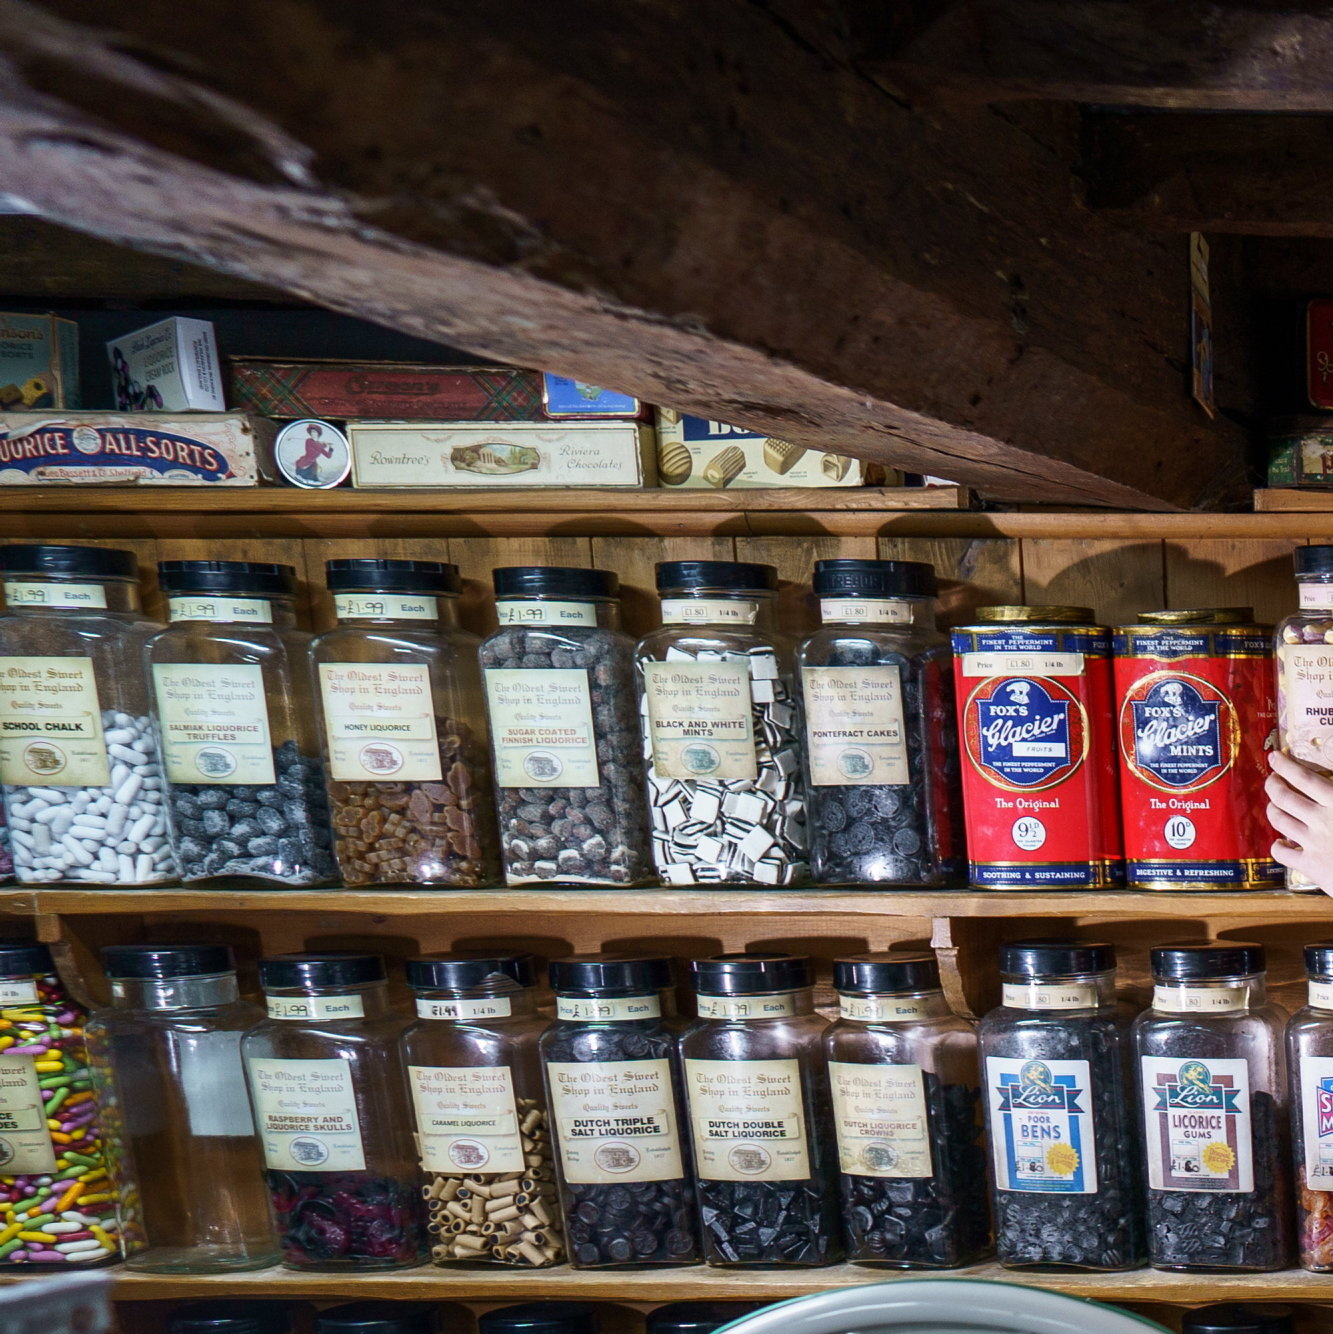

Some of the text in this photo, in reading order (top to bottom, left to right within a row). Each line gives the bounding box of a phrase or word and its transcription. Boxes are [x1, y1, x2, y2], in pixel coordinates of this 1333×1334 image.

[105, 432, 219, 471] ALL-SORTS
[559, 445, 600, 458] Riviera
[369, 452, 431, 468] Rowntree's
[565, 458, 623, 470] Chocolates
[989, 706, 1028, 716] FOX'S
[1145, 707, 1182, 717] FOX'S
[2, 721, 84, 731] SCHOOL CHALK
[655, 720, 745, 730] BLACK AND WHITE
[1137, 713, 1215, 747] Glacier
[683, 728, 714, 737] MINTS
[813, 730, 898, 738] PONTEFRACT CAKES
[983, 712, 1065, 751] Glacier
[1170, 746, 1213, 756] MINTS
[995, 798, 1059, 811] The Original
[1150, 799, 1210, 811] The Original
[1014, 1088, 1060, 1106] Lion
[1171, 1087, 1217, 1106] Lion
[574, 1116, 654, 1127] DUTCH TRIPLE
[1027, 1116, 1051, 1124] POOR
[1172, 1116, 1222, 1130] LICORICE
[571, 1125, 660, 1136] SALT LIQUORICE
[1021, 1126, 1061, 1140] BENS
[1184, 1130, 1212, 1139] GUMS
